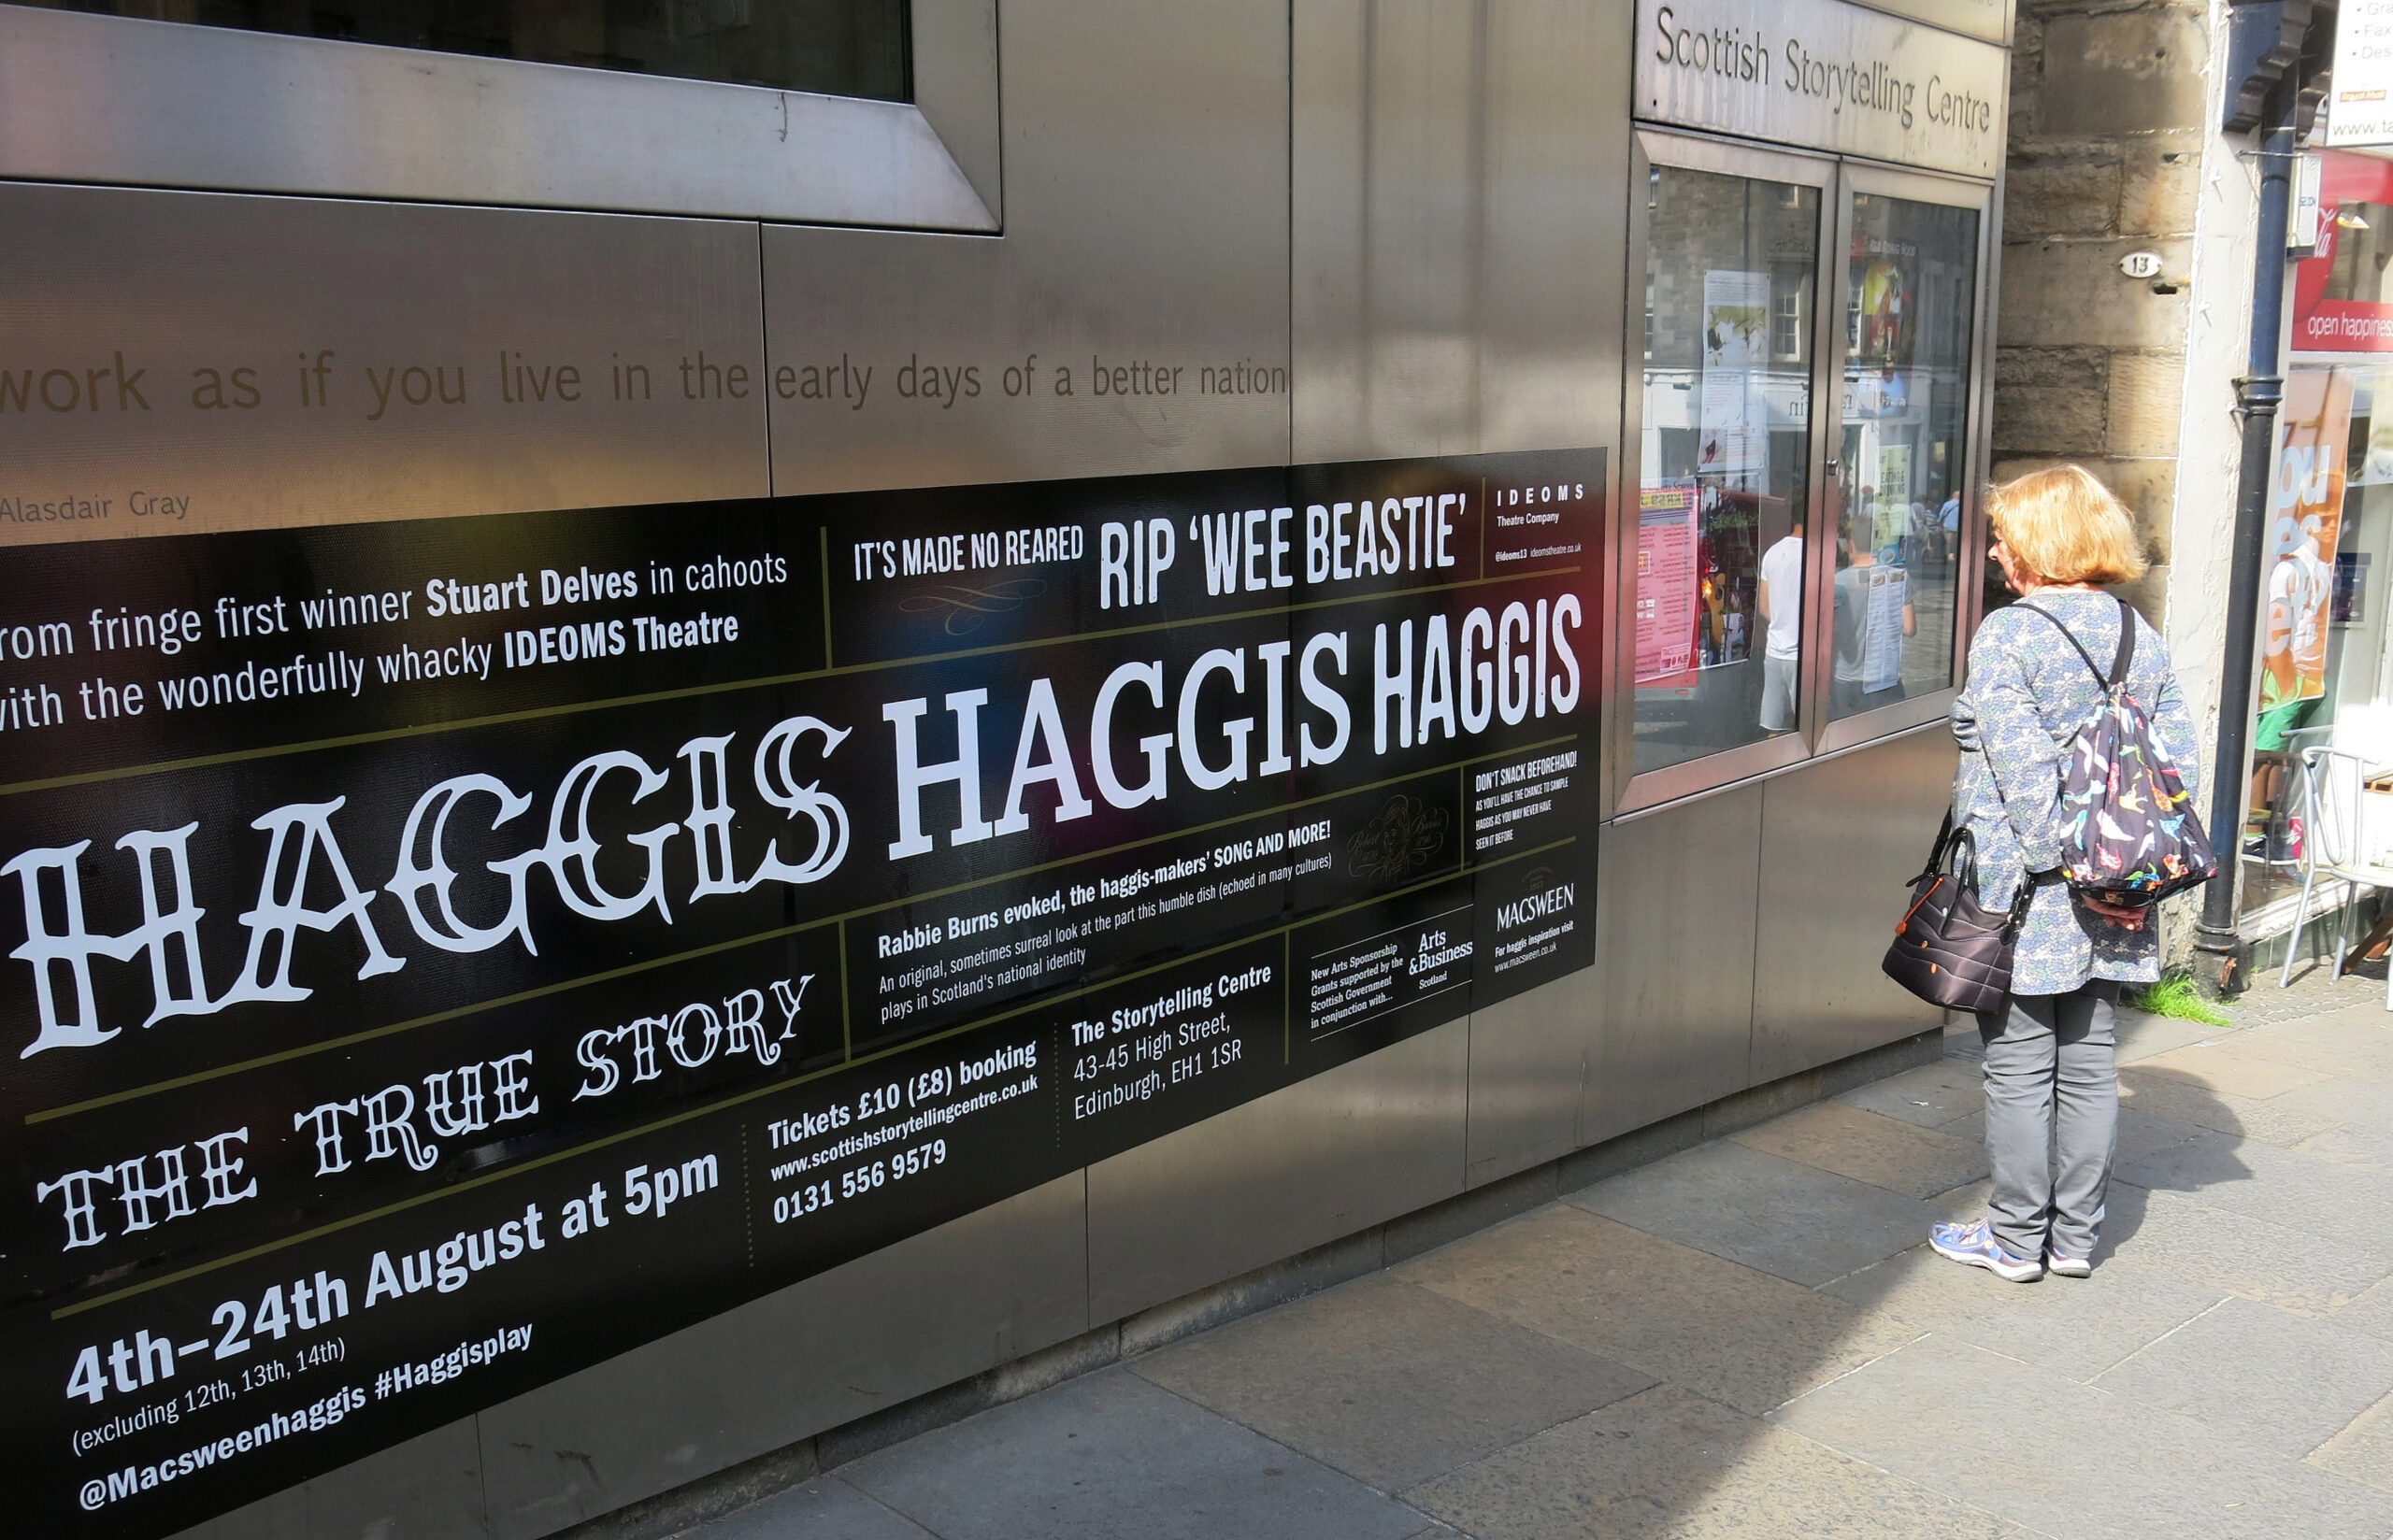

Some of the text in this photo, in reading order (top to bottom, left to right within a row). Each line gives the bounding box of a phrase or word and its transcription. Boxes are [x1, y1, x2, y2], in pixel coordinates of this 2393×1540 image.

[1655, 7, 1990, 133] Scottish Storytelling Centre
[2132, 256, 2149, 274] 13
[2308, 316, 2338, 340] open
[191, 365, 263, 411] as
[298, 351, 332, 407] if
[365, 355, 467, 420] you
[499, 351, 581, 404] live
[612, 353, 651, 400] in
[681, 351, 750, 399] the
[775, 353, 873, 410] early
[896, 354, 982, 409] days
[1002, 354, 1038, 397] of
[1054, 362, 1074, 396] a
[1093, 355, 1182, 396] better
[1200, 357, 1288, 394] nation
[129, 491, 191, 520] Gray
[1497, 483, 1583, 506] IDEOMS
[1497, 512, 1560, 527] Theatre Company
[902, 535, 966, 577] MADE
[970, 532, 999, 569] NO
[1005, 525, 1083, 566] REARED
[1100, 518, 1176, 610] RIP
[1495, 542, 1582, 563] @ideoms13 ideomstheatre.co.uk
[88, 606, 202, 655] fringe
[214, 595, 289, 638] first
[300, 589, 412, 630] winner
[426, 572, 530, 618] Stuart
[540, 565, 638, 606] Delves
[650, 560, 674, 594] in
[685, 552, 787, 592] cahoots
[79, 677, 144, 720] the
[157, 650, 365, 711] wonderfully
[376, 636, 492, 684] whacky
[504, 620, 626, 668] IDEOMS
[632, 611, 738, 652] Theatre
[1500, 763, 1526, 786] SNACK
[1527, 749, 1578, 779] BEFOREHAND!
[1476, 799, 1483, 812] AS
[1500, 791, 1514, 806] HAVE
[1514, 788, 1524, 802] THE
[1524, 783, 1543, 799] CHANCE
[1543, 781, 1551, 792] TO
[1550, 777, 1569, 791] SAMPLE
[1476, 799, 1552, 832] HAGGIS AS YOU MAY NEVER HAVE
[0, 715, 853, 1059] HAGGIS
[881, 631, 1351, 865] HAGGIS
[1374, 593, 1582, 755] HAGGIS
[1476, 829, 1513, 850] SEEN IT BEFORE
[878, 923, 942, 959] Rabbie
[948, 911, 999, 940] Burns
[1004, 890, 1066, 925] evoked,
[1069, 884, 1096, 906] the
[1213, 840, 1253, 868] SONG
[1255, 832, 1284, 858] AND
[1288, 820, 1331, 848] MORE!
[1497, 882, 1574, 932] MACSWEEN
[879, 852, 1332, 994] An original, sometimes surreal look at the part this humble dish (echoed in many cultures)
[1418, 929, 1447, 953] Arts
[1495, 920, 1574, 958] For haggis inspiration visit
[1311, 943, 1398, 981] New Arts Sponsorship
[1311, 956, 1404, 997] Grants supported by the
[1409, 940, 1473, 976] &Business
[1419, 970, 1448, 990] Scotland
[1495, 941, 1557, 973] www.macsween.co.uk
[881, 948, 1086, 1025] plays in Scotland's national identity
[1071, 966, 1271, 1047] The Storytelling Centre
[1311, 975, 1393, 1013] Scottish Government
[1311, 991, 1394, 1029] in conjunction with...
[1073, 1012, 1230, 1082] 43-45 High Street,
[767, 1040, 1039, 1150] Tickets £10 (£8) booking
[1073, 1038, 1241, 1121] Edinburgh, EH1 1SR
[36, 973, 816, 1252] THE TRUE STORY
[770, 1076, 1039, 1182] www.scottishstorytellingcentre.co.uk
[773, 1138, 946, 1224] 0131 556 9579
[365, 1203, 546, 1308] August
[562, 1181, 609, 1239] at
[624, 1153, 719, 1219] 5pm
[73, 1337, 345, 1457] (excluding 12th, 13th, 14th)
[79, 1323, 533, 1511] @Macsweenhaggis #Haggisplay
